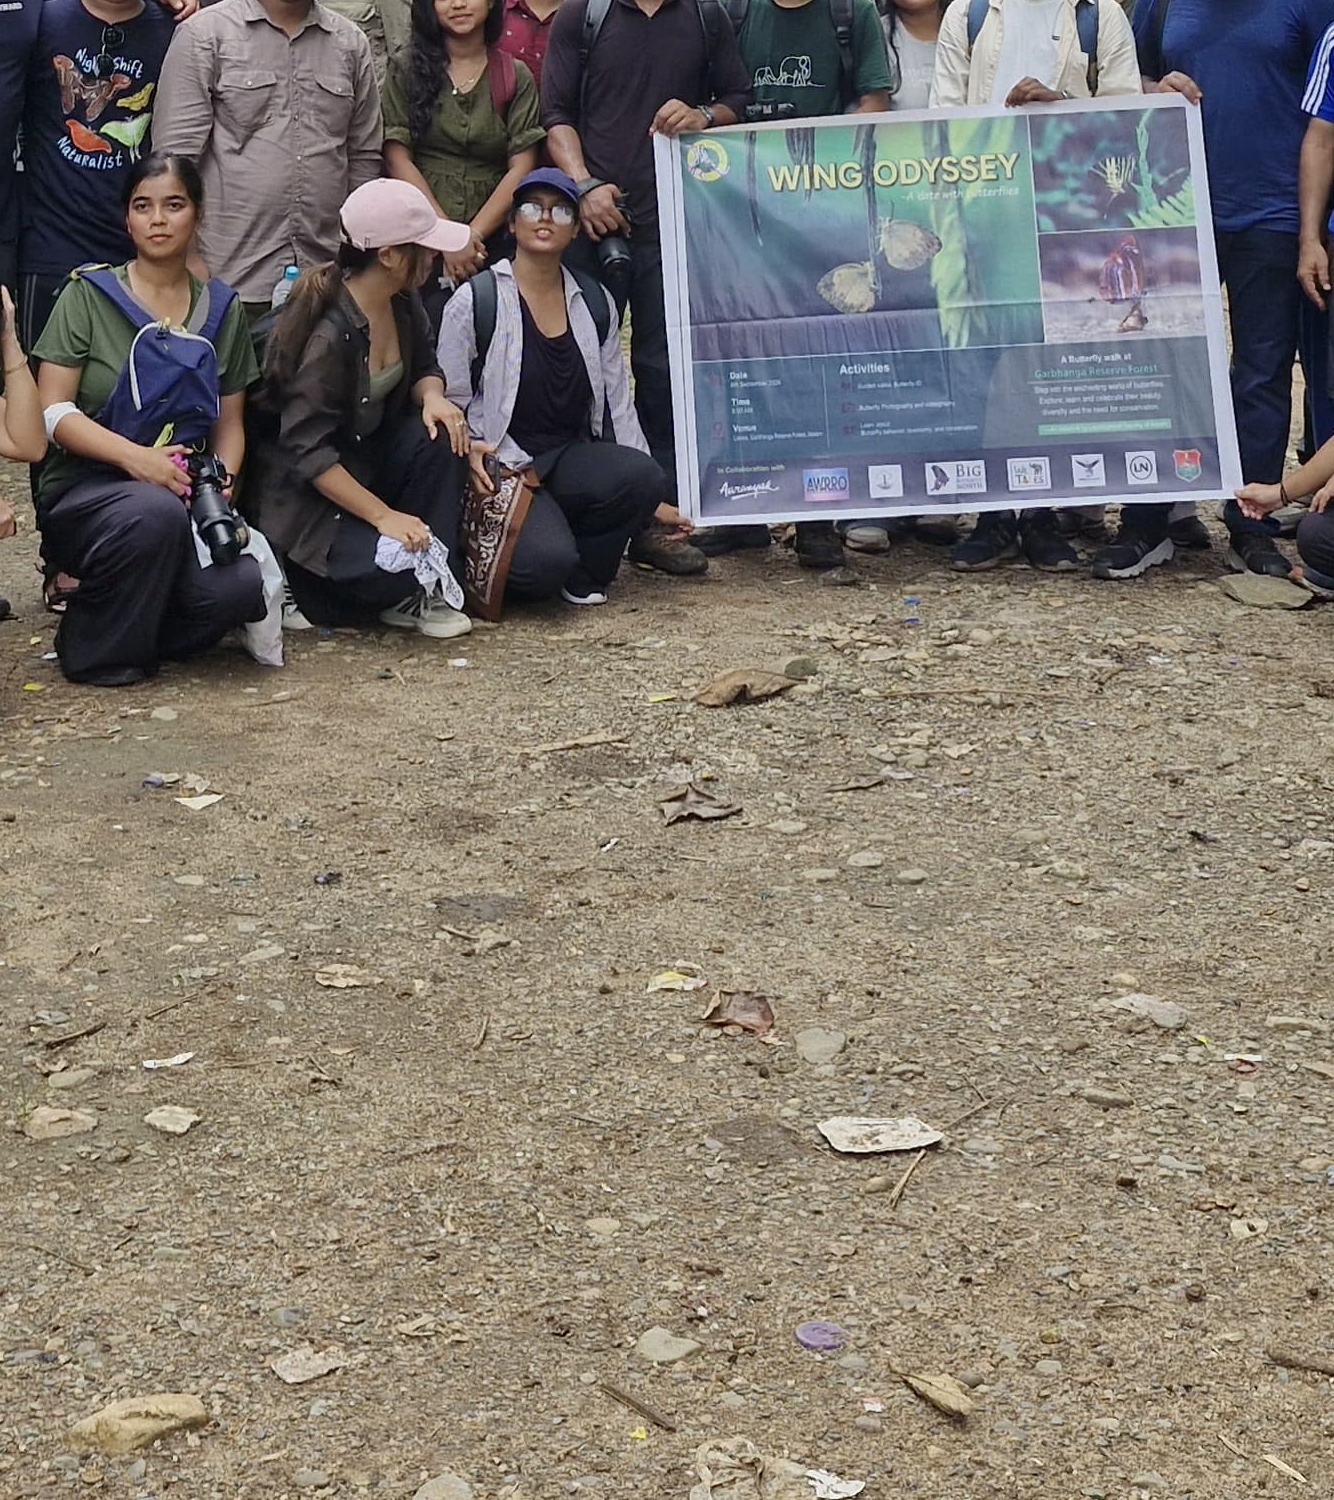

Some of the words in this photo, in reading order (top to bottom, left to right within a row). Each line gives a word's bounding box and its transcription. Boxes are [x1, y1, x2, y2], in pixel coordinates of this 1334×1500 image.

[75, 48, 99, 74] Nig
[113, 57, 144, 79] Shift
[767, 163, 863, 191] WING
[873, 153, 1020, 186] ODYSSEY
[917, 190, 940, 200] date
[942, 188, 964, 199] with
[1060, 355, 1068, 364] A
[1069, 354, 1101, 364] Butterfly
[1103, 353, 1122, 362] walk
[1124, 353, 1132, 361] at
[839, 362, 890, 375] Activities
[1089, 366, 1126, 376] Reserve
[1128, 364, 1157, 374] Forest
[729, 371, 748, 380] Date
[731, 398, 751, 406] Time
[770, 464, 786, 472] with
[1134, 463, 1149, 473] LN
[807, 475, 848, 492] AWRRO
